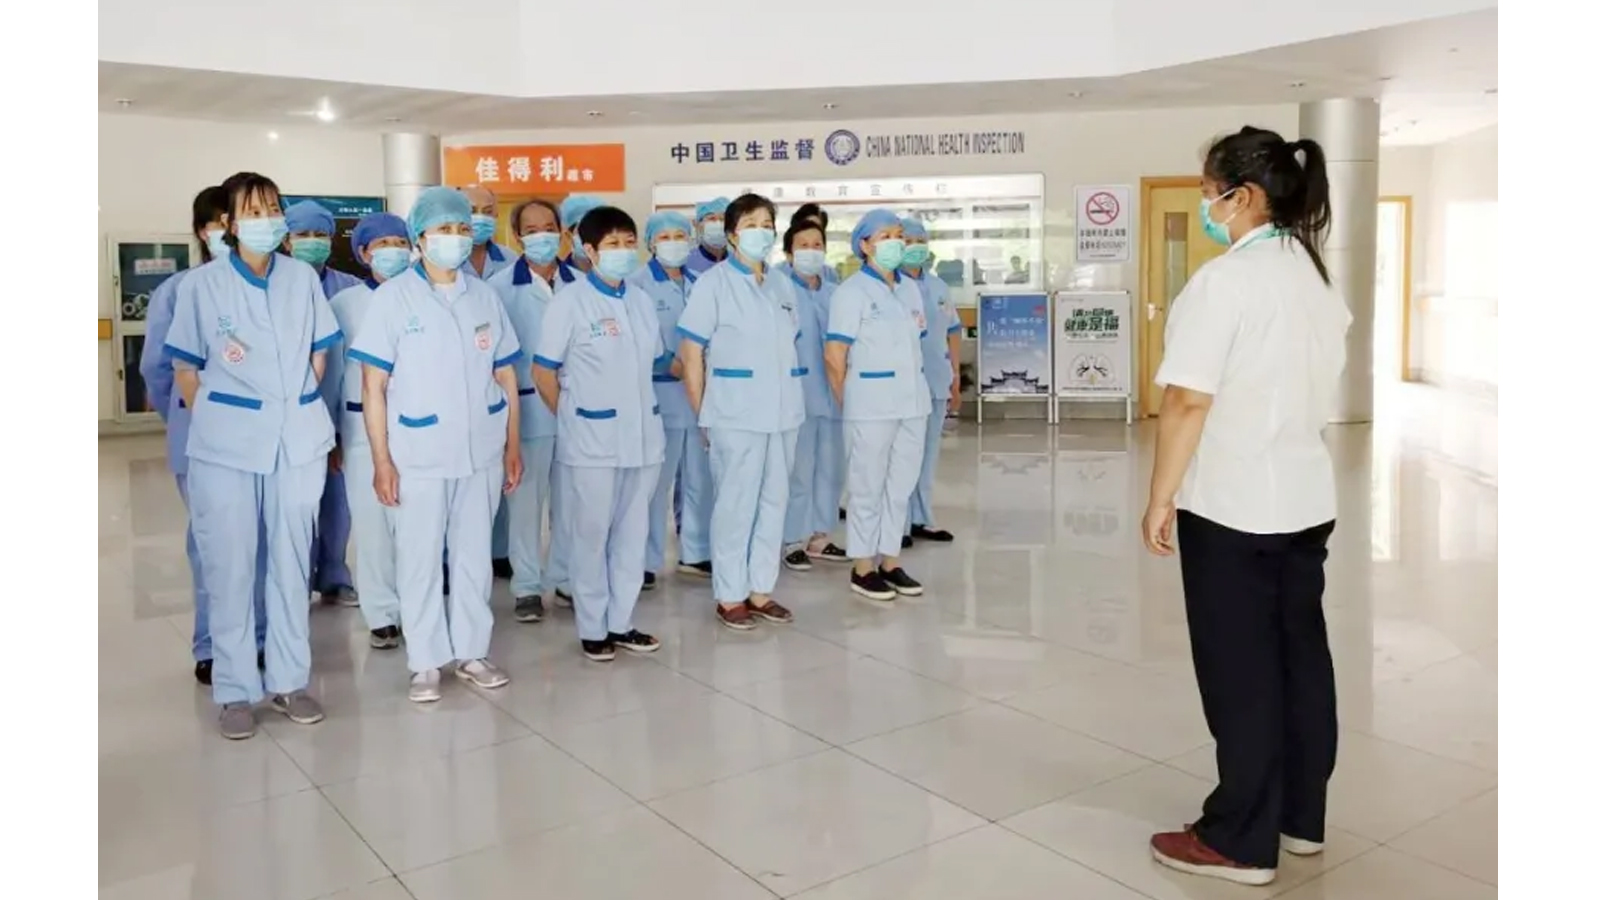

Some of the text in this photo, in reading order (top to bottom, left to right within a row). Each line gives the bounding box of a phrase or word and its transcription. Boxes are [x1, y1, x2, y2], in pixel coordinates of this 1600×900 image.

[671, 138, 815, 163] 中国卫生监督
[866, 135, 891, 157] CHINA
[894, 134, 935, 156] NATIONAL
[938, 133, 970, 155] HEALTH
[973, 131, 1025, 153] INSPECTION
